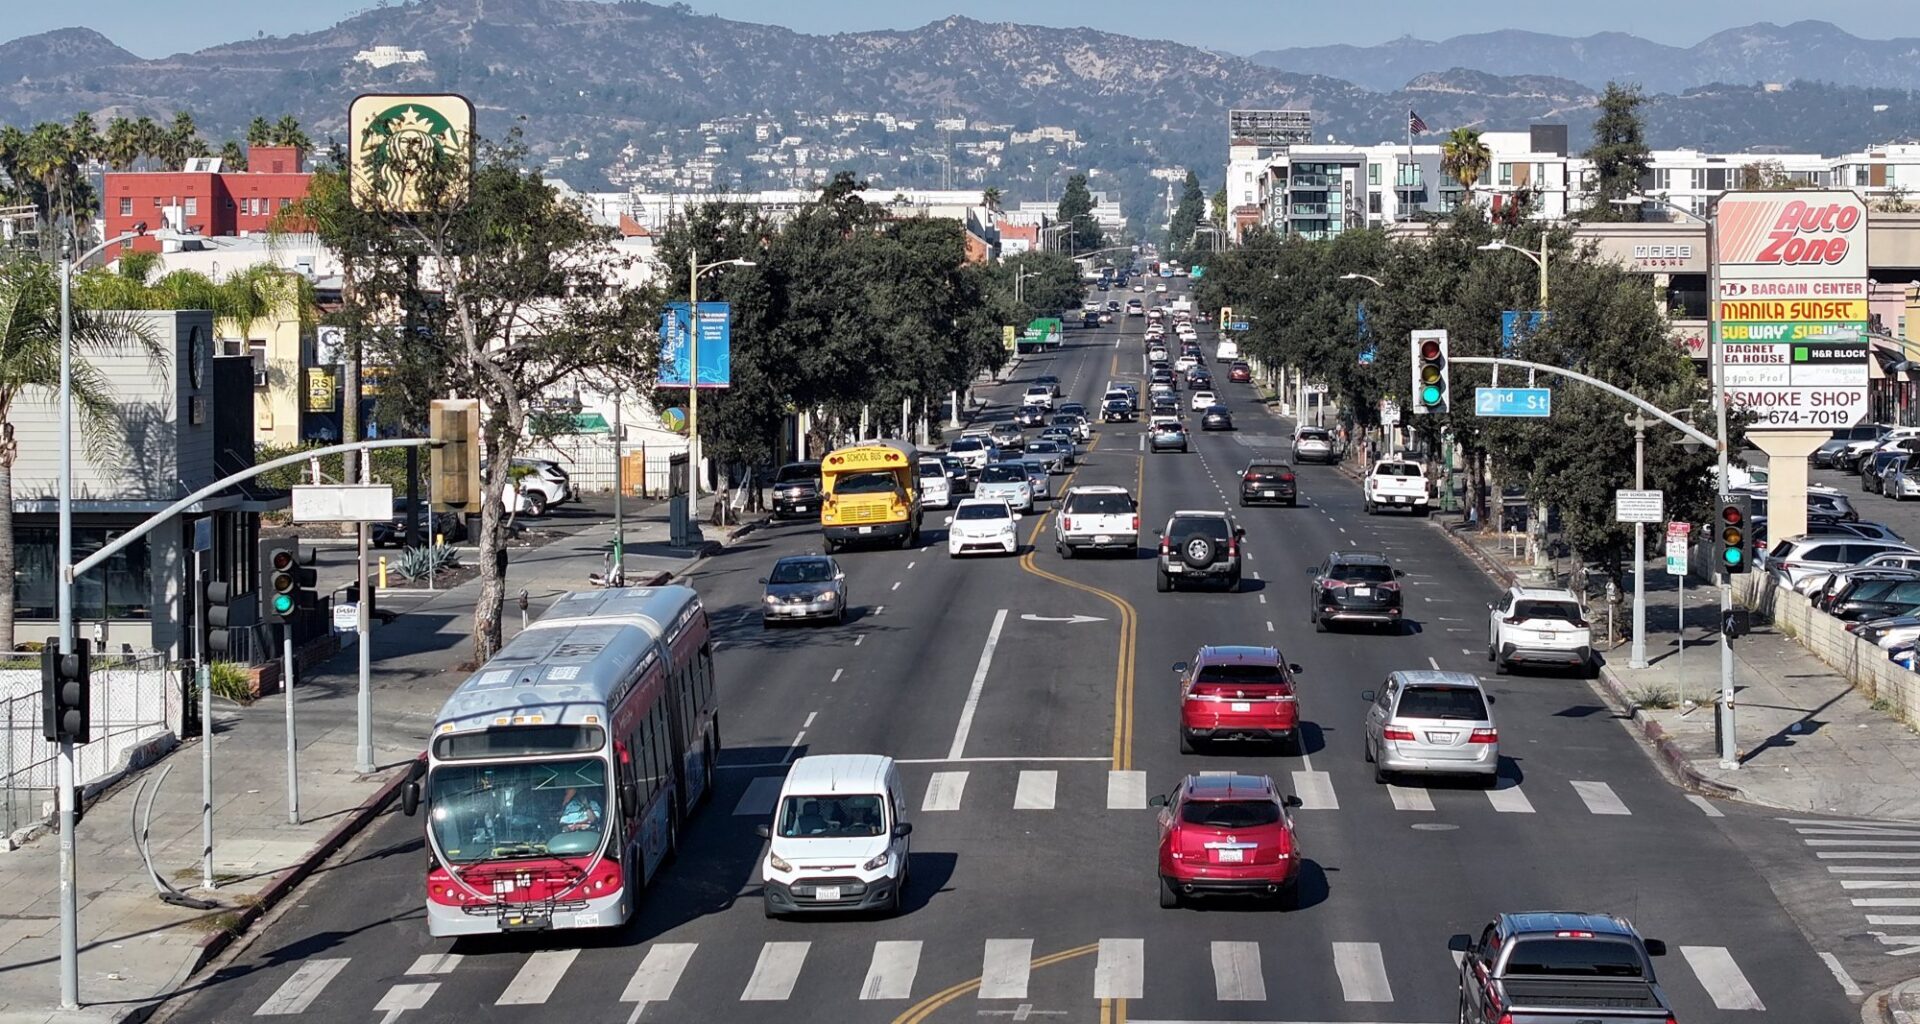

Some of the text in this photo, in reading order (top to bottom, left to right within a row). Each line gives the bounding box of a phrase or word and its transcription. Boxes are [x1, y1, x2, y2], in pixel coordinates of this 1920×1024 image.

[1774, 200, 1859, 232] Auto
[1635, 245, 1691, 257] MAZE
[1756, 231, 1849, 265] Zone
[1751, 283, 1808, 295] BARGAIN
[1813, 283, 1862, 295] CENTER
[1721, 302, 1853, 319] MANILA SUNSET
[1722, 325, 1788, 340] SUBWAY
[1726, 344, 1775, 353] BAGNET
[1811, 350, 1866, 358] H&R BLOCK
[1743, 354, 1785, 363] HOUSE
[1479, 392, 1546, 412] 2nd St
[1735, 391, 1861, 406] SMOKE SHOP
[847, 452, 881, 462] SCHOOL BUS
